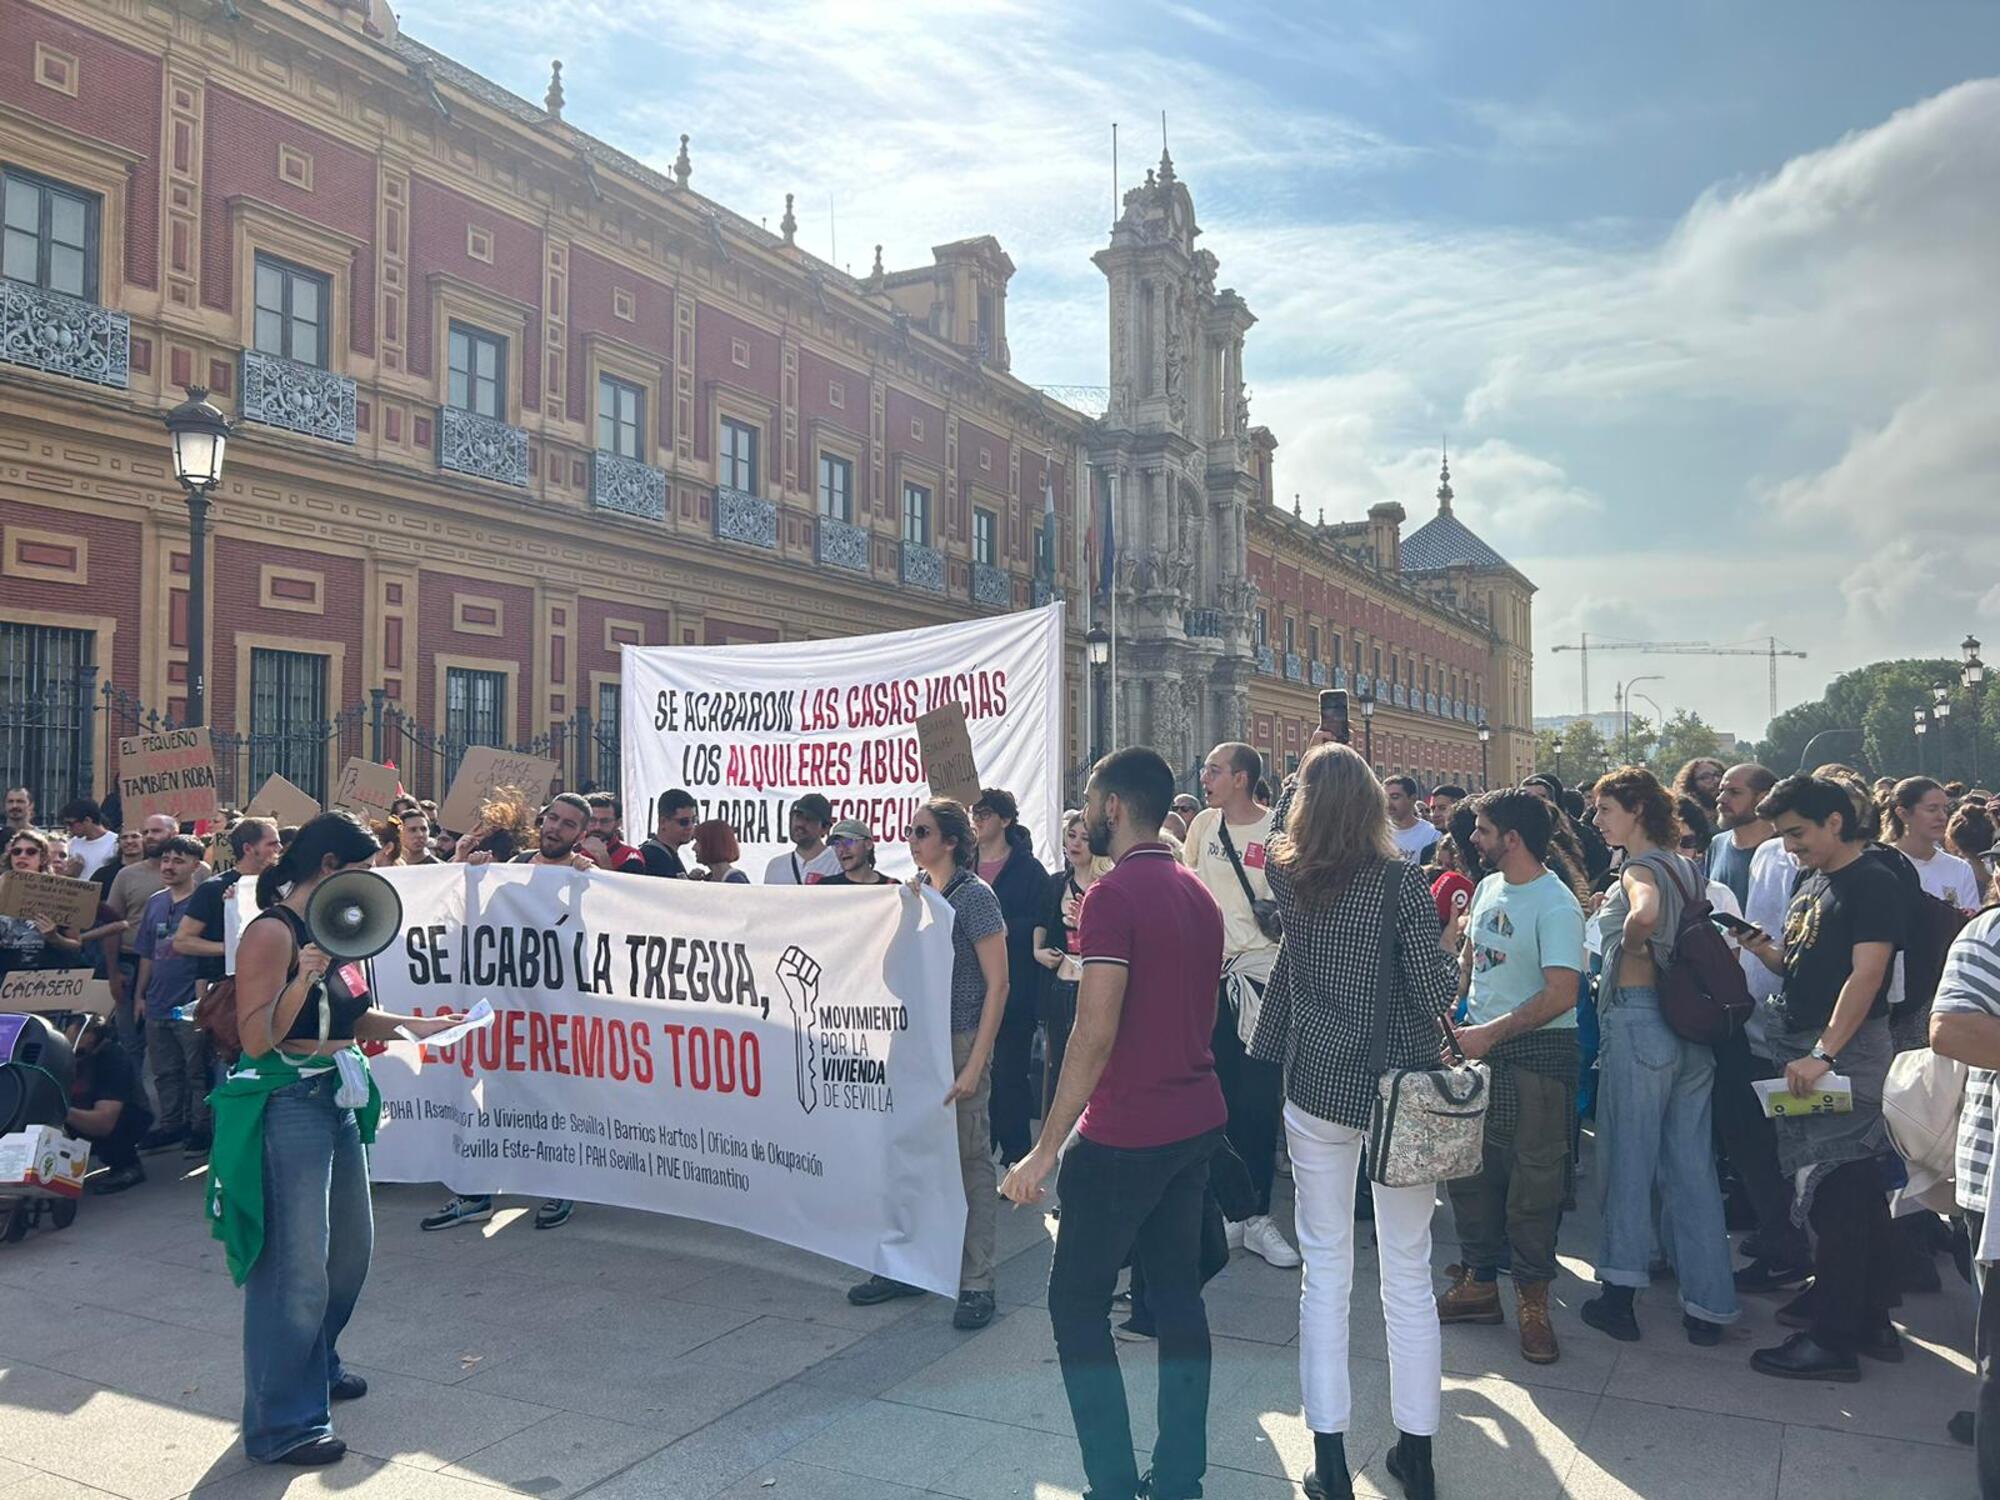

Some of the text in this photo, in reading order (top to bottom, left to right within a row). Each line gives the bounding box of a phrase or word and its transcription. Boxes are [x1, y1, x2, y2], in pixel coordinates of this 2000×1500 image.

[654, 690, 679, 732] SE
[684, 690, 795, 732] ACABARON
[800, 687, 839, 731] LAS
[846, 679, 919, 728] CASAS
[925, 664, 1007, 720] VACÍAS
[121, 731, 198, 755] EL PEQUEÑO
[122, 766, 215, 798] TAMBIÉN ROBA
[682, 744, 722, 787] LOS
[726, 742, 851, 792] ALQUILERES
[406, 914, 770, 1021] SE ACABÓ LA TREGUA,
[1, 979, 84, 999] CACASERO
[819, 1005, 908, 1031] MOVIMIENTO
[461, 1008, 654, 1084] QUEREMOS
[664, 1024, 762, 1098] TODO
[821, 1032, 868, 1057] POR LA
[822, 1057, 886, 1085] VIVIENDA
[823, 1083, 894, 1113] DE SEVILLA
[477, 1107, 490, 1128] la
[493, 1107, 548, 1131] Vivienda
[551, 1111, 567, 1131] de
[569, 1112, 606, 1137] Sevilla
[614, 1118, 656, 1144] Barrios
[658, 1124, 698, 1150] Hartos
[707, 1130, 748, 1159] Oficina
[751, 1139, 766, 1162] de
[767, 1141, 824, 1178] Okupación
[461, 1138, 499, 1159] evilla
[502, 1138, 576, 1164] Este-Amate
[585, 1144, 608, 1168] PAH
[609, 1148, 646, 1174] Sevilla
[656, 1153, 681, 1180] PIVE
[683, 1159, 750, 1193] Diamantino
